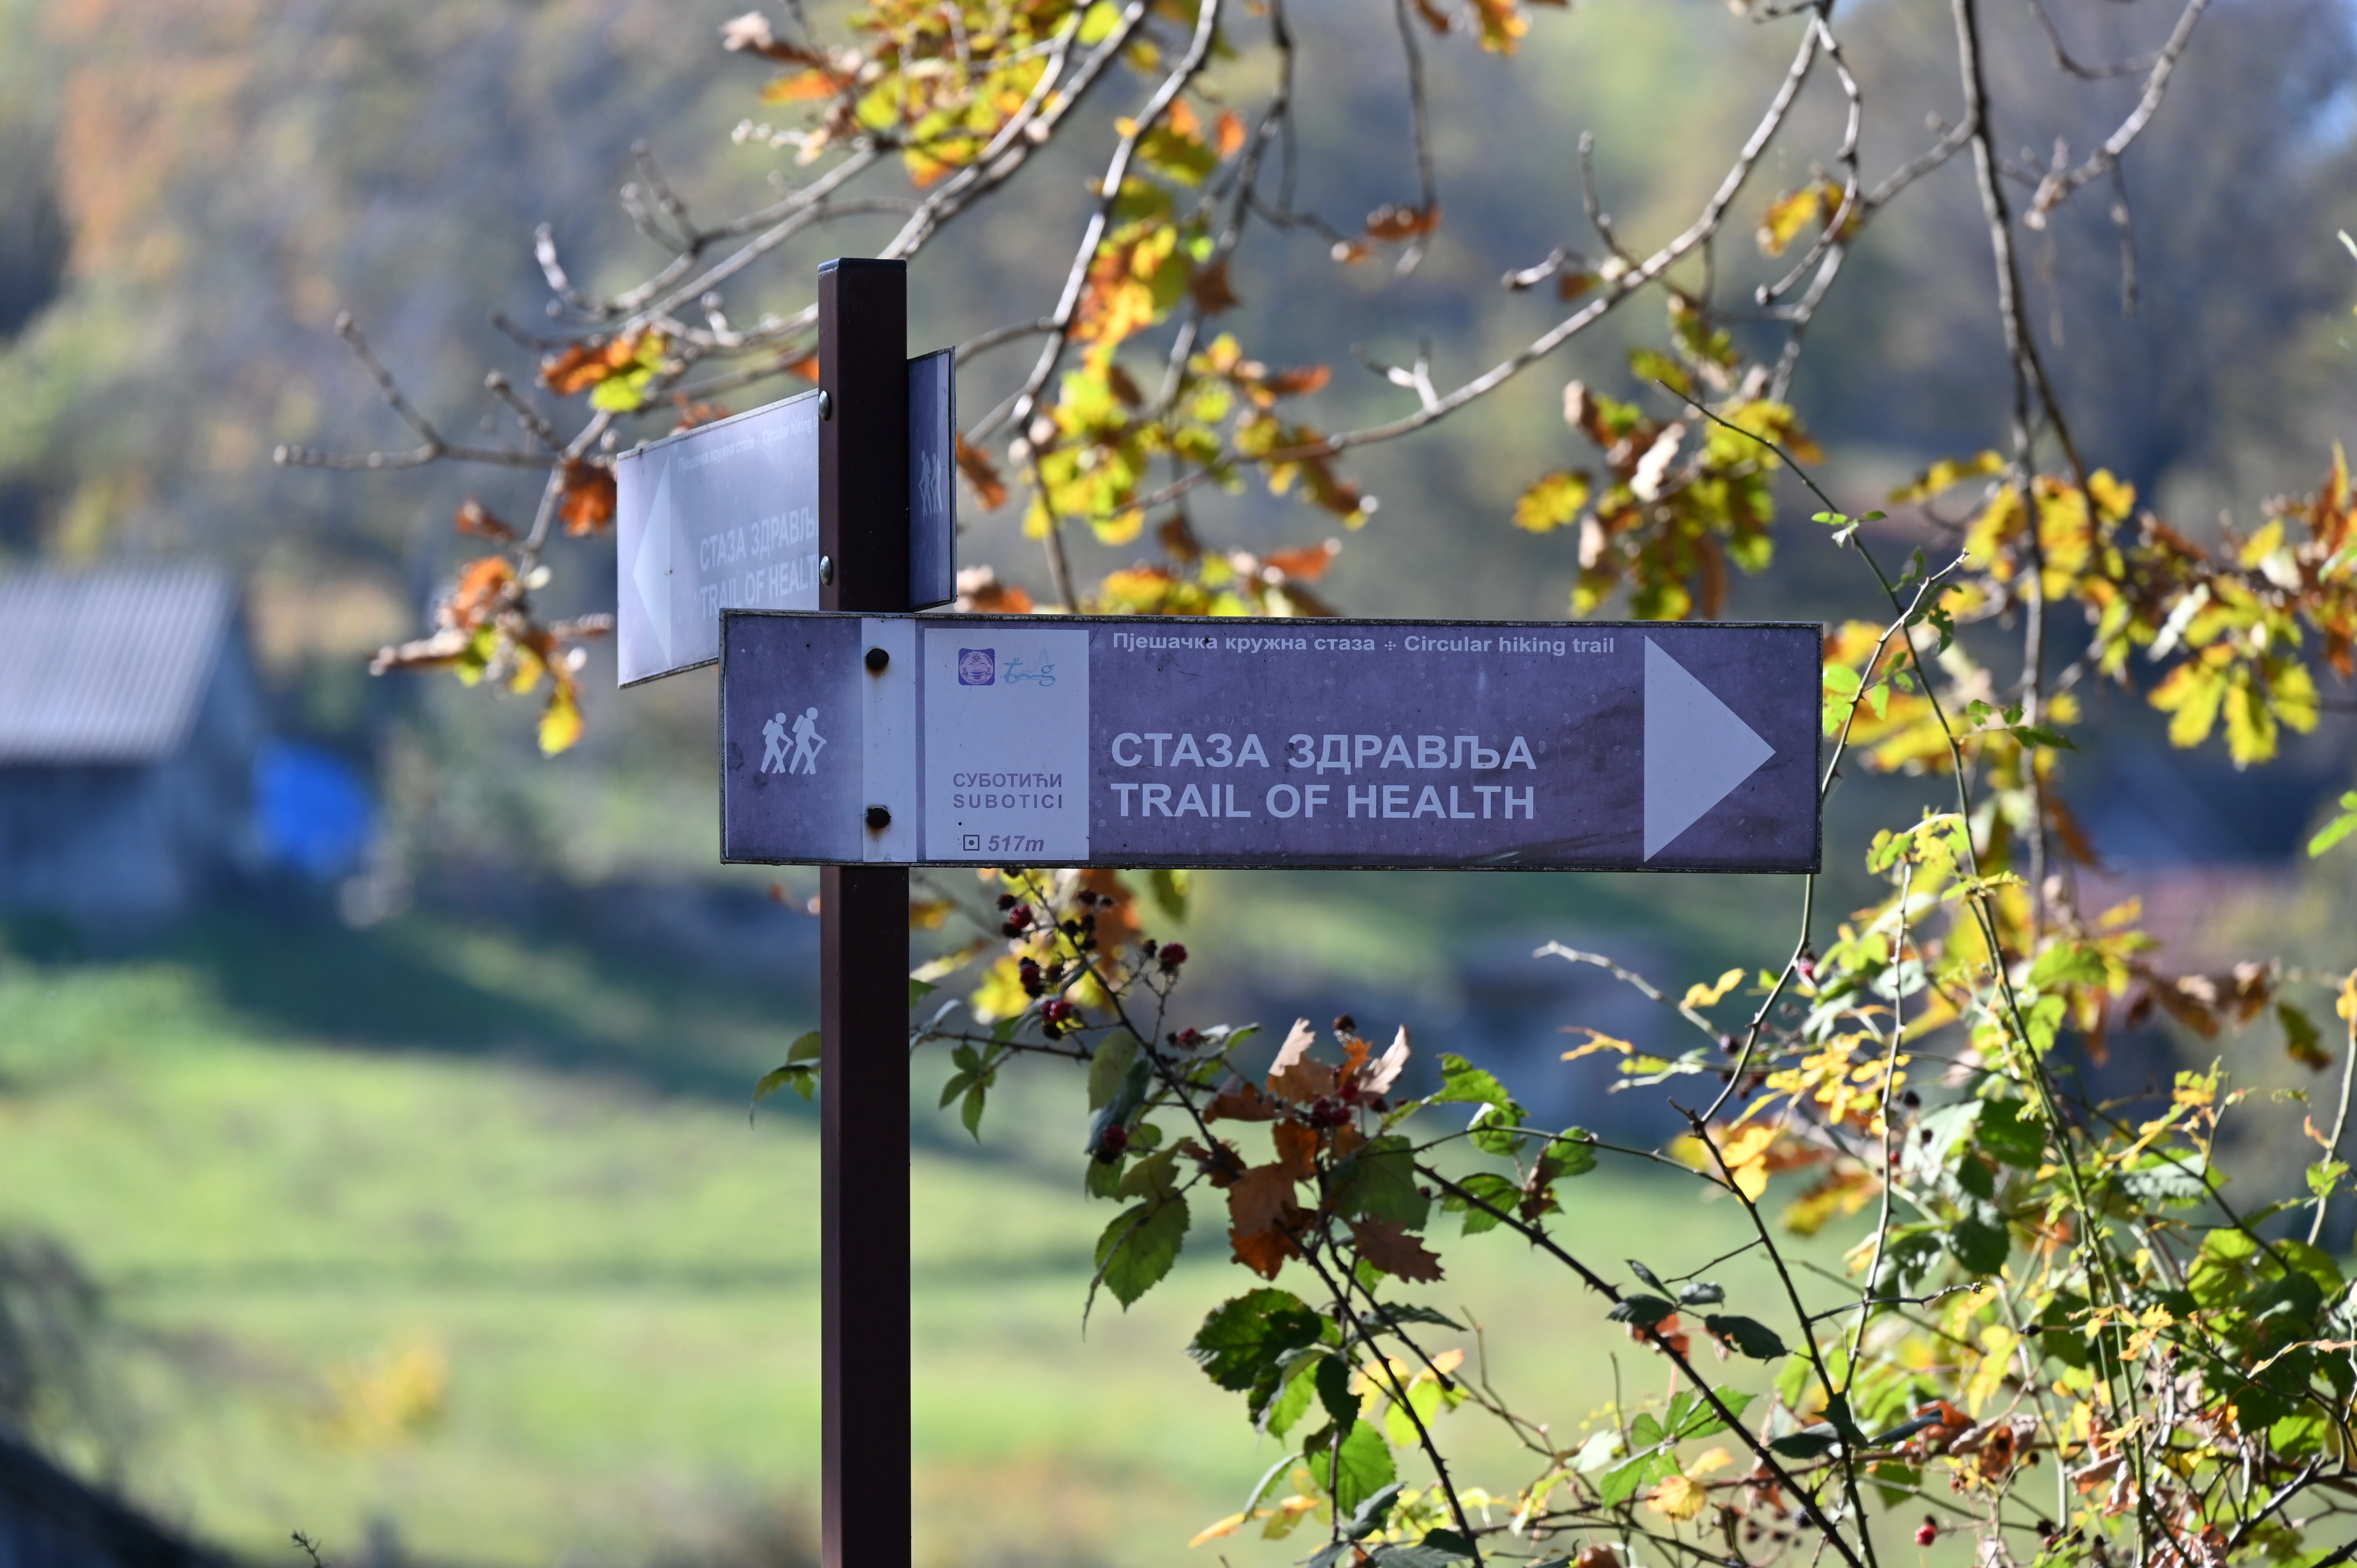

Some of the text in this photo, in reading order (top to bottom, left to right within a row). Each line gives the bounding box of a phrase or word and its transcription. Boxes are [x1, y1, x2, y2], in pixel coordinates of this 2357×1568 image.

[762, 424, 789, 444] Circular
[791, 417, 812, 435] hiking
[736, 437, 754, 453] стаза
[700, 506, 819, 571] СТАЗА ЗДРАВЉ
[700, 553, 819, 619] TRAIL OF HEALT
[1113, 632, 1375, 653] Пјешачка кружна стаза
[1405, 636, 1614, 657] Circular hiking trail
[1111, 732, 1537, 775] СТАЗА ЗДРАВЉА
[953, 772, 1062, 788] СУБОТИЋИ
[953, 794, 1062, 809] SUBOTICI
[1110, 783, 1534, 819] TRAIL OF HEALTH
[988, 835, 1044, 852] 517m
